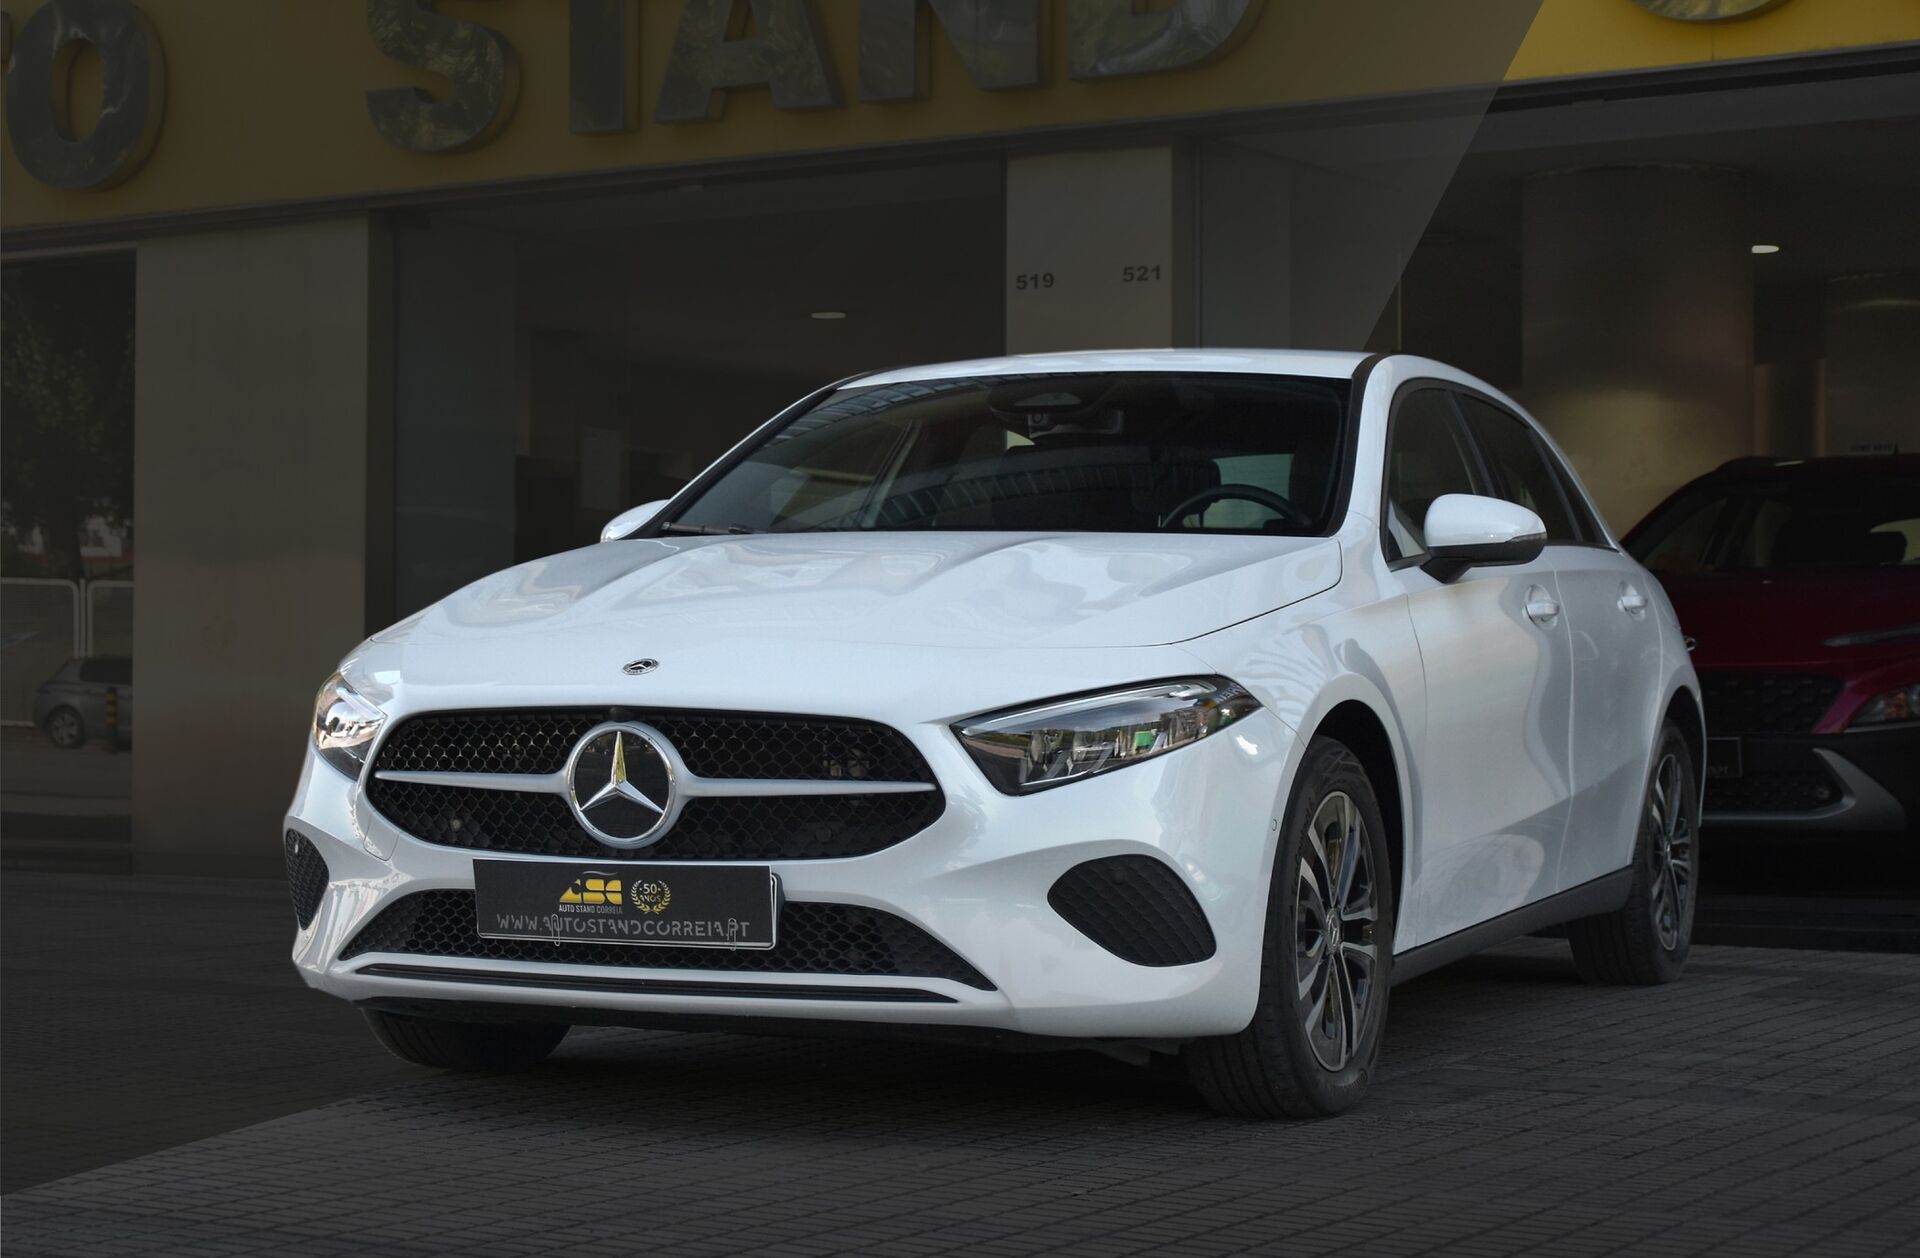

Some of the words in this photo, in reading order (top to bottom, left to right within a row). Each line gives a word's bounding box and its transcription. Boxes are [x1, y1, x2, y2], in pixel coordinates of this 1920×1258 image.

[1122, 264, 1161, 282] 521
[1016, 272, 1055, 290] 519
[644, 883, 658, 895] 50
[558, 904, 575, 914] AUTO
[576, 904, 595, 914] STAND
[596, 905, 623, 915] CORREIA
